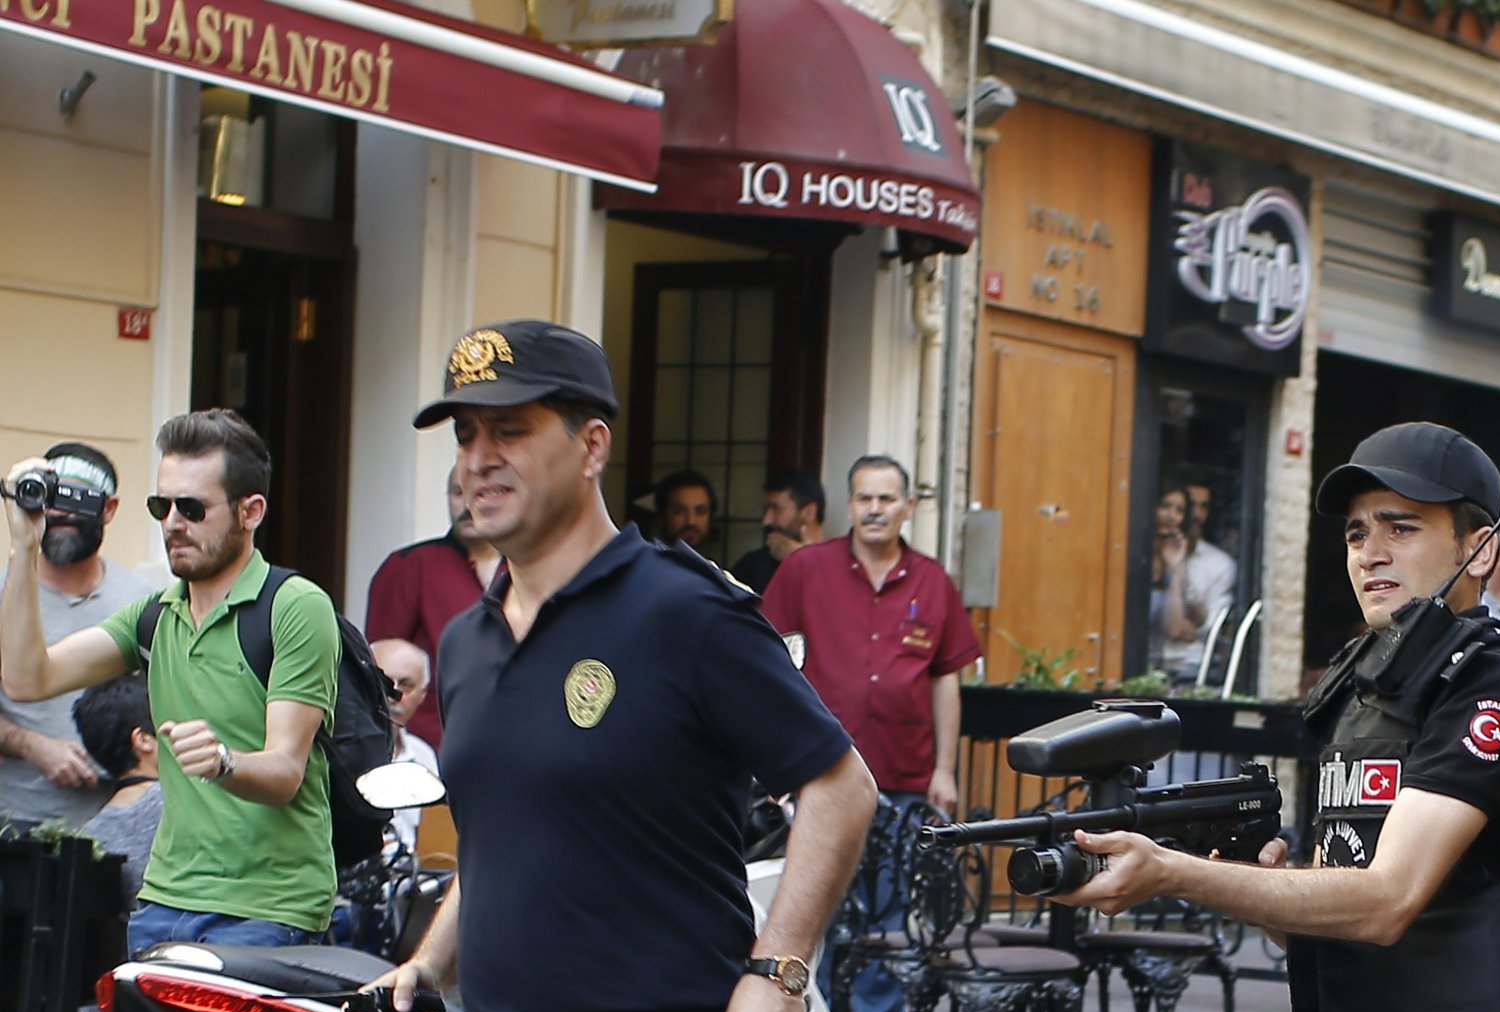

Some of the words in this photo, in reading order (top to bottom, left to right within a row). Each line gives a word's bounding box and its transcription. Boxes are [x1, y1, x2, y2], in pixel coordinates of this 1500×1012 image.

[128, 0, 395, 113] PASTANESİ
[884, 76, 941, 151] IQ
[737, 161, 790, 208] IQ
[801, 172, 935, 219] HOUSES
